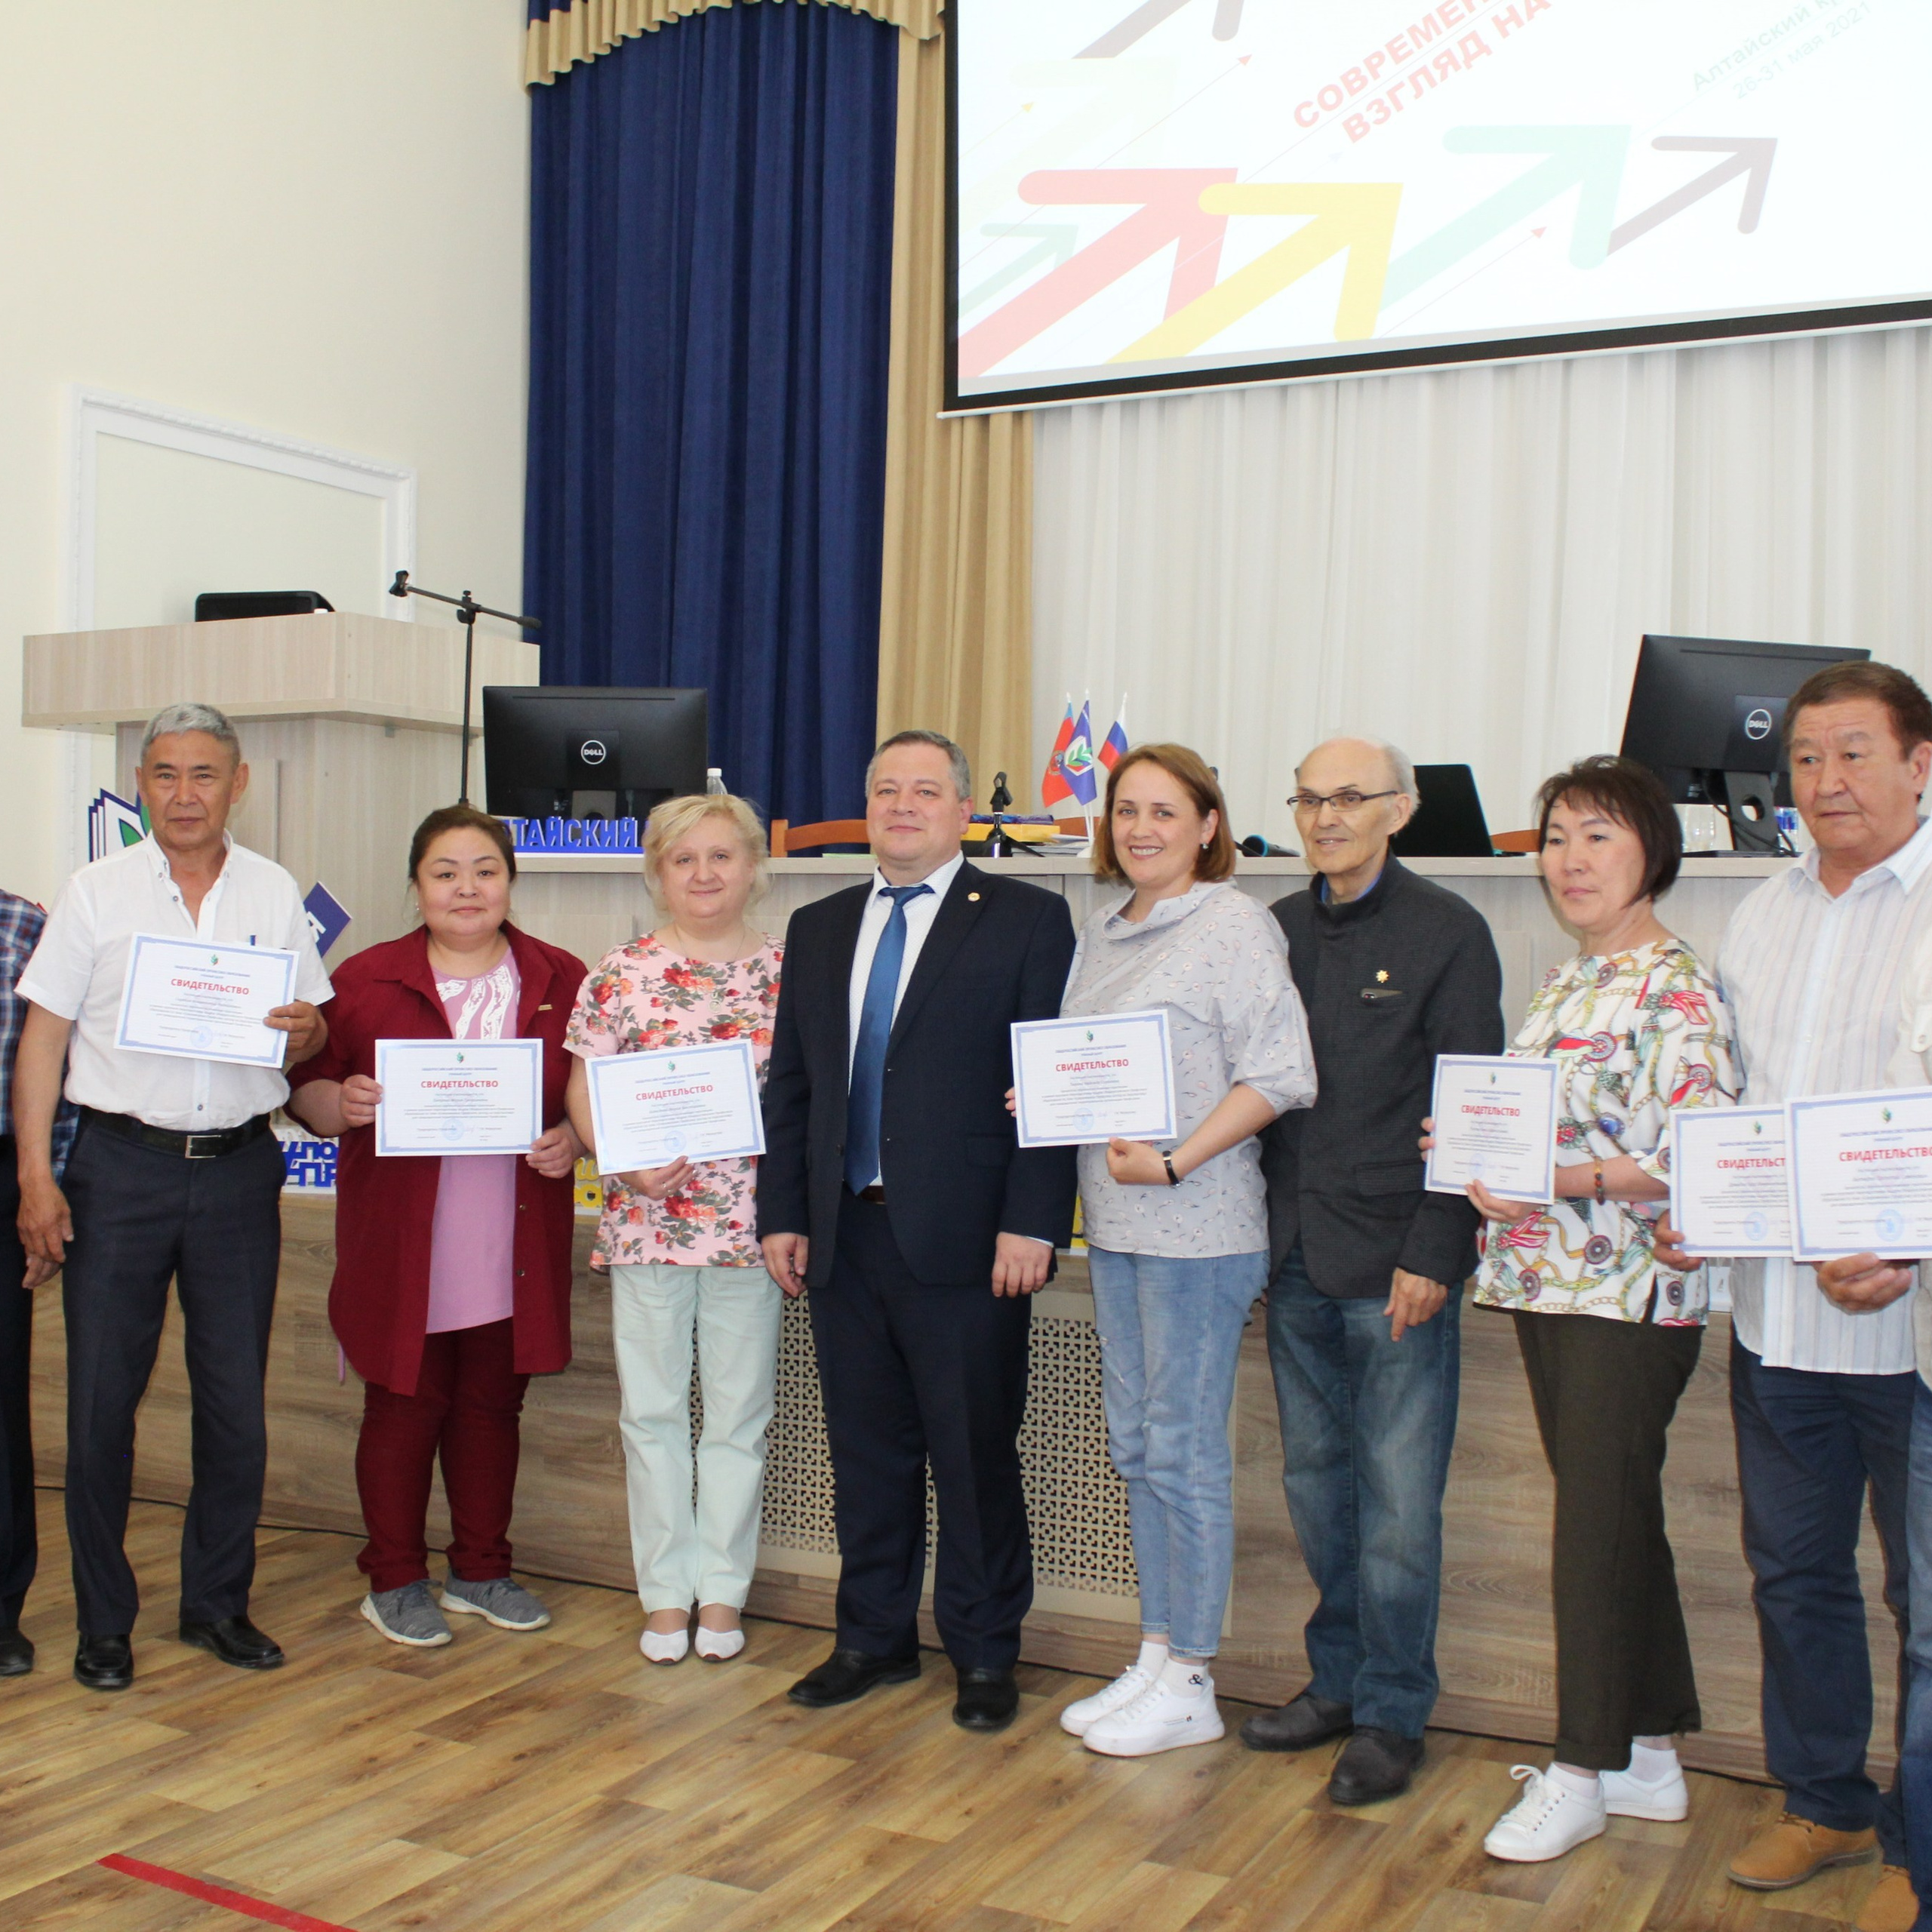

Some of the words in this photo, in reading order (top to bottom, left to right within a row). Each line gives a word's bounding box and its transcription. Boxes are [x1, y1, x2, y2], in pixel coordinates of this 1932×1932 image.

[1693, 3, 1811, 91] Алтайский
[1732, 59, 1784, 99] 26-31
[1786, 35, 1825, 64] мая
[1825, 1, 1872, 38] 2021
[1342, 29, 1493, 143] ВЗГЛЯД
[1491, 0, 1552, 38] НА
[504, 816, 638, 848] ТАЙСКИЙ
[171, 978, 250, 995] СВИДЕТЕЛЬСТВО
[1056, 1059, 1129, 1072] СВИДЕТЕЛЬСТВО
[421, 1081, 498, 1090] СВИДЕТЕЛЬСТВО
[635, 1084, 713, 1100] СВИДЕТЕЛЬСТВО
[1461, 1105, 1520, 1116] СВИДЕТЕЛЬСТВО
